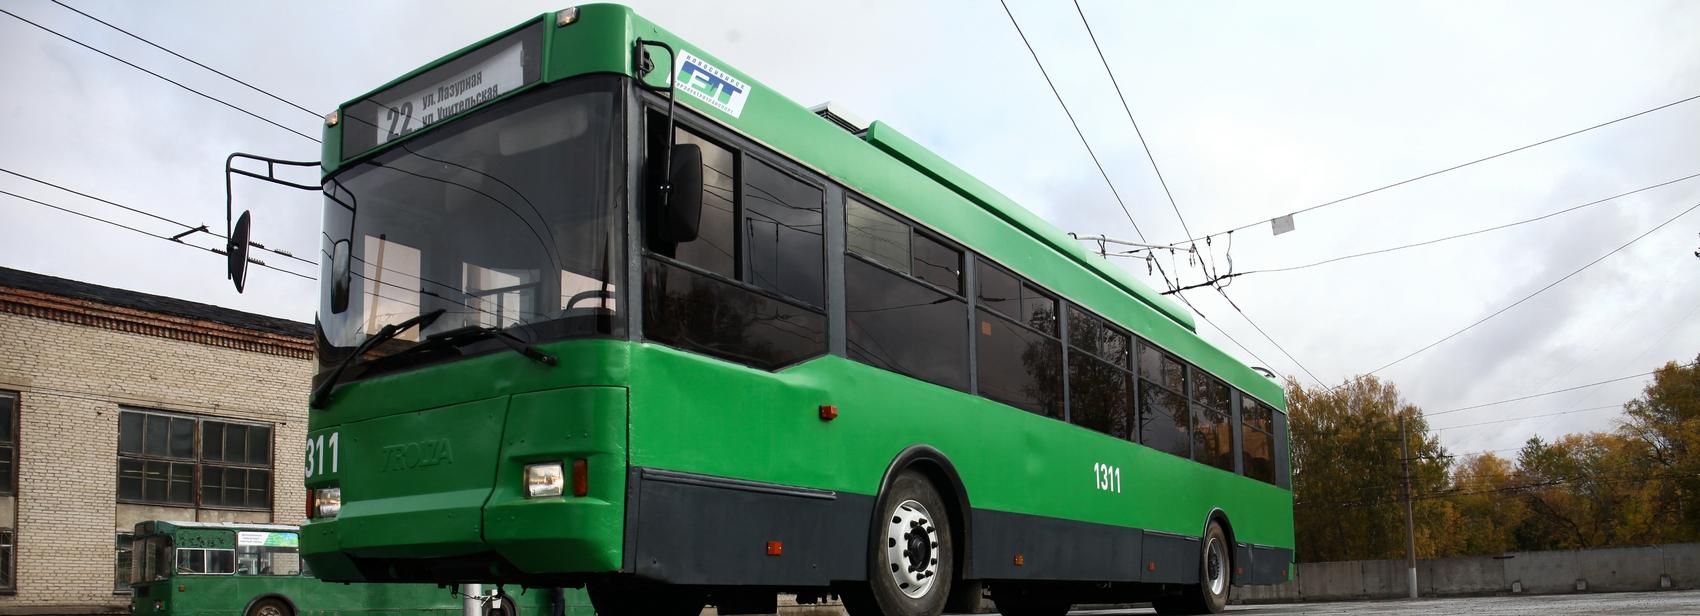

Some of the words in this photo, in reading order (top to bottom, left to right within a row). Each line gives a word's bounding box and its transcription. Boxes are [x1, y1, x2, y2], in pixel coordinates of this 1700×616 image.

[686, 55, 745, 89] НОВОСИБИРСК
[422, 93, 436, 111] ул.
[437, 71, 482, 103] Лазурная
[386, 101, 413, 142] 22
[422, 113, 434, 126] ул
[1093, 462, 1121, 494] 1311
